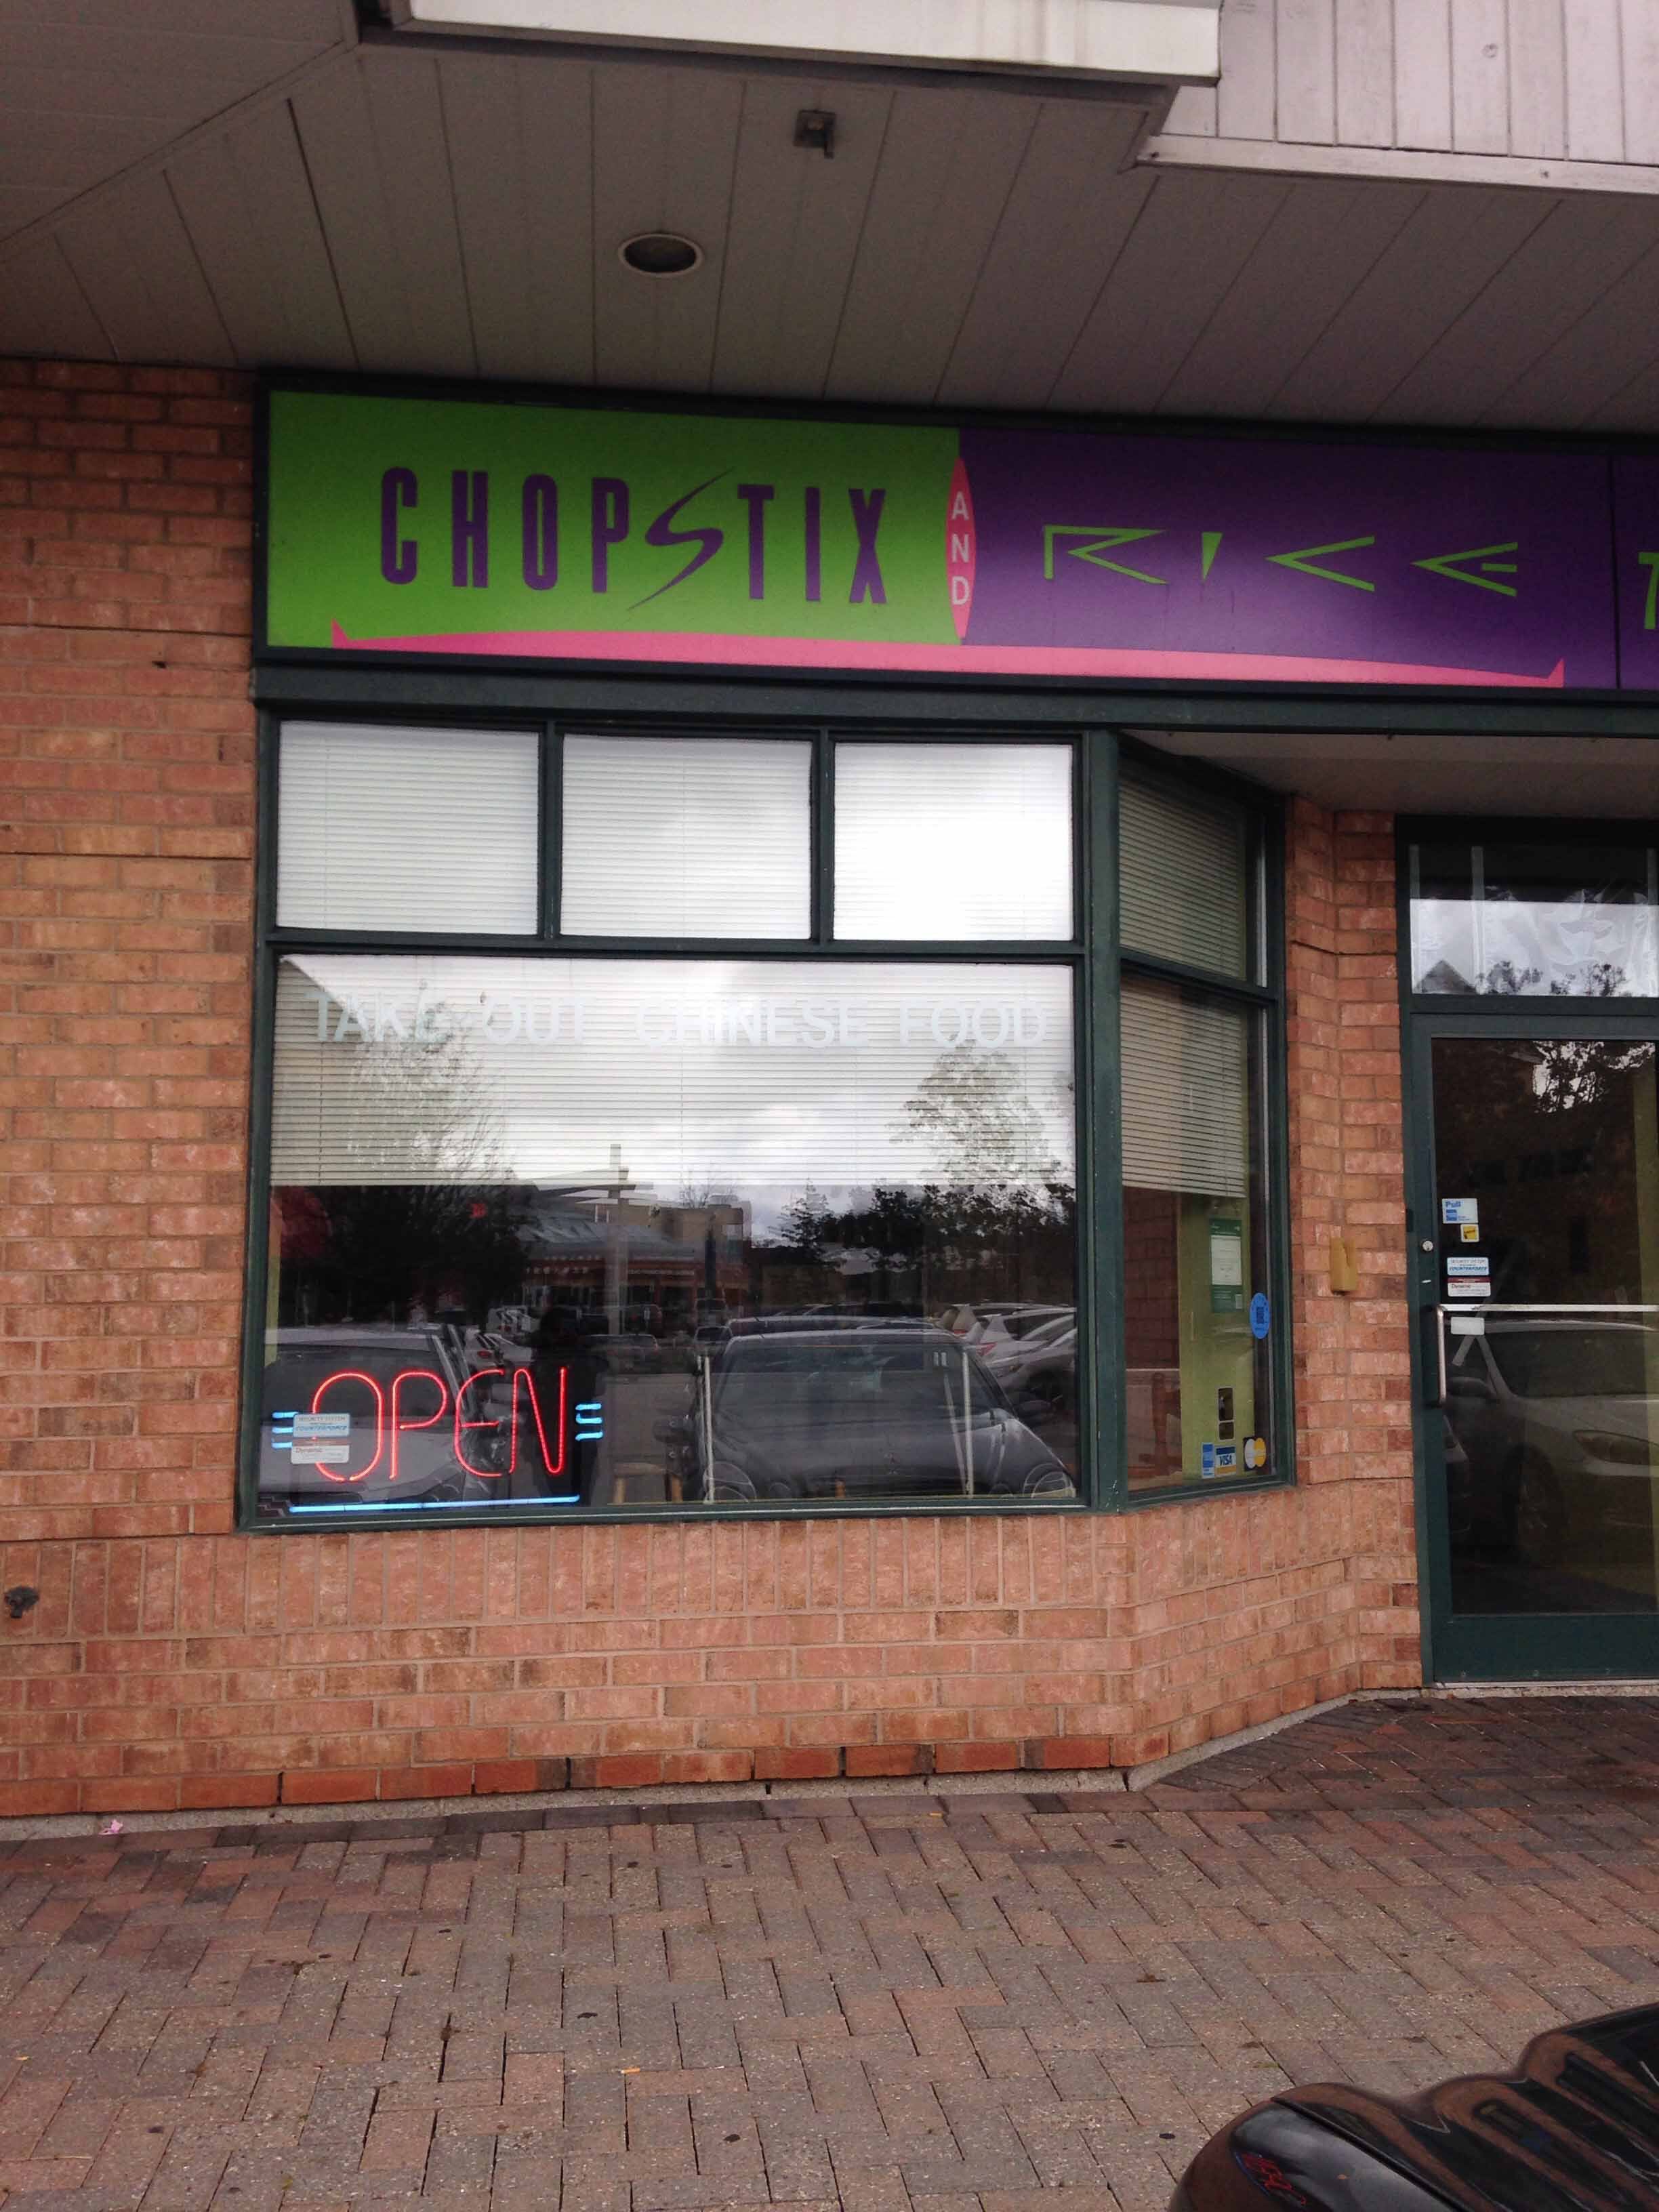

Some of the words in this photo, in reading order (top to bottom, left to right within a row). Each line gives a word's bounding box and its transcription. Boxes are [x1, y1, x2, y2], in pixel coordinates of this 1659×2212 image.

[381, 466, 886, 611] CHOPSTIX
[951, 491, 970, 605] AND
[305, 991, 449, 1043] TAKE
[483, 995, 596, 1044] OUT
[635, 996, 869, 1048] CHINESE
[899, 997, 1047, 1048] FOOD
[311, 1367, 567, 1481] OPEN
